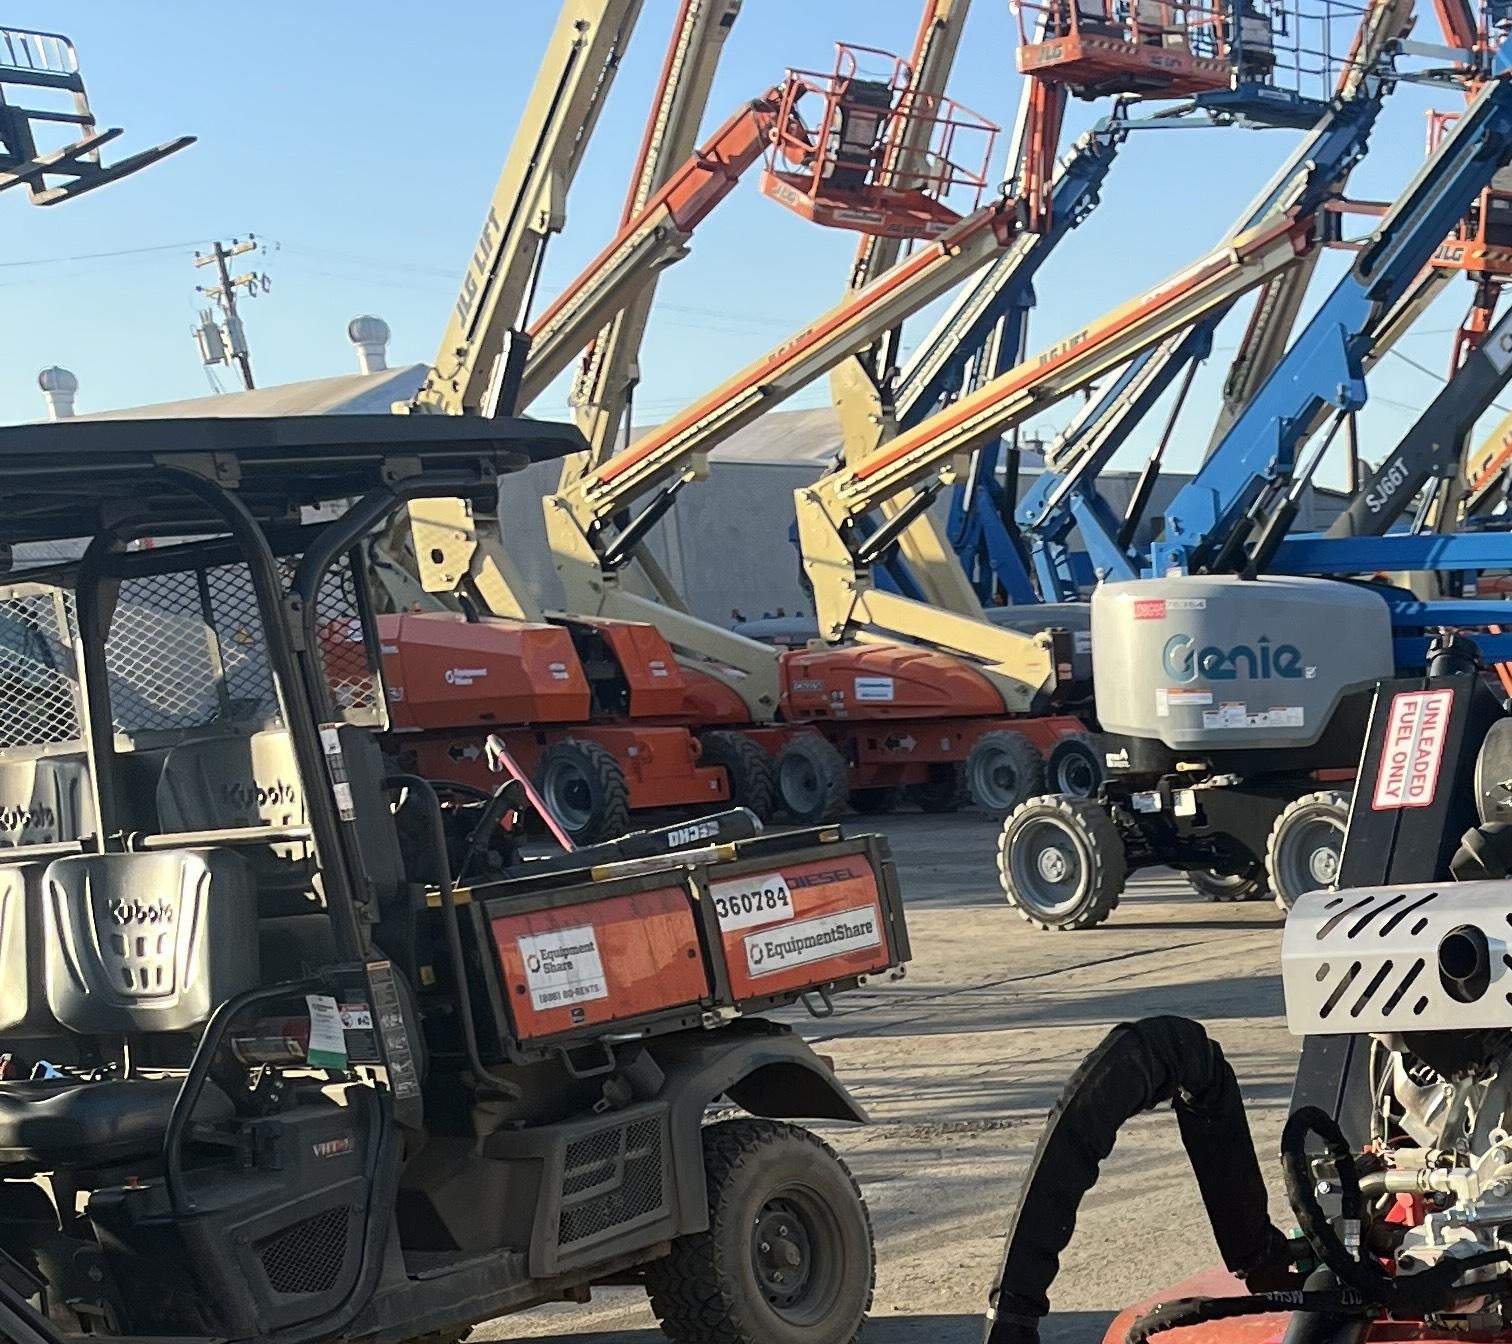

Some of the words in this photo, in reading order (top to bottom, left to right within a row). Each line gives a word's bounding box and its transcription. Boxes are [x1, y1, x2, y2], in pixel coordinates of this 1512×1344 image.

[456, 270, 478, 330] JLG
[474, 205, 500, 276] LIFT
[1435, 245, 1465, 262] JLG
[1366, 457, 1411, 514] SJ66T
[1162, 633, 1304, 684] Genie
[1394, 700, 1418, 748] FUEL
[1408, 698, 1443, 798] UNLEADED
[1384, 750, 1409, 799] ONLY
[785, 867, 863, 890] DIESEL
[715, 885, 790, 919] 360784
[540, 940, 596, 964] Equipment
[765, 919, 874, 959] EquipmentShare
[543, 958, 574, 976] Share
